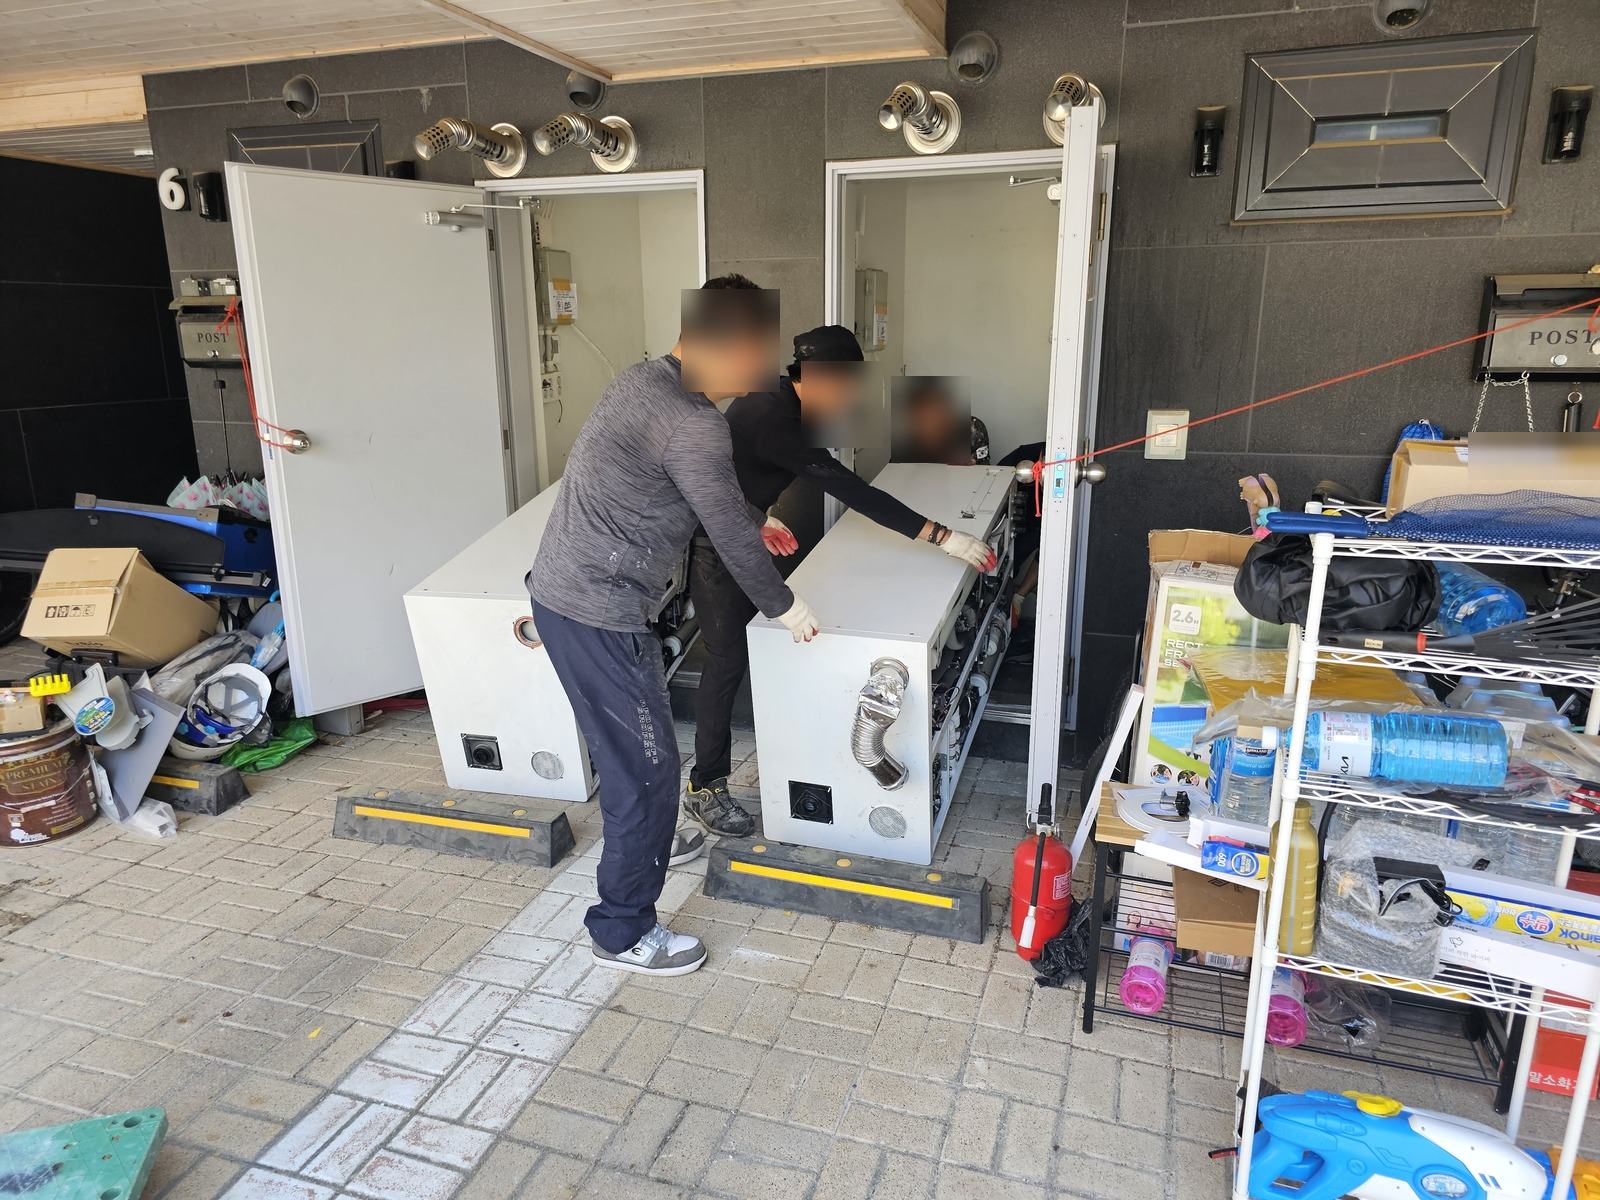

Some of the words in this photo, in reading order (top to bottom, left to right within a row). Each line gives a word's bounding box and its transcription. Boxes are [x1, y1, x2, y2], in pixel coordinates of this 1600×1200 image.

[158, 168, 186, 211] 6
[197, 332, 227, 343] POST
[1529, 329, 1593, 346] POST
[1166, 638, 1206, 650] RECT
[6, 761, 63, 780] PREMIUM
[1519, 913, 1549, 933] 발수
[1559, 927, 1600, 945] ainOK
[1528, 1071, 1577, 1090] 말소화
